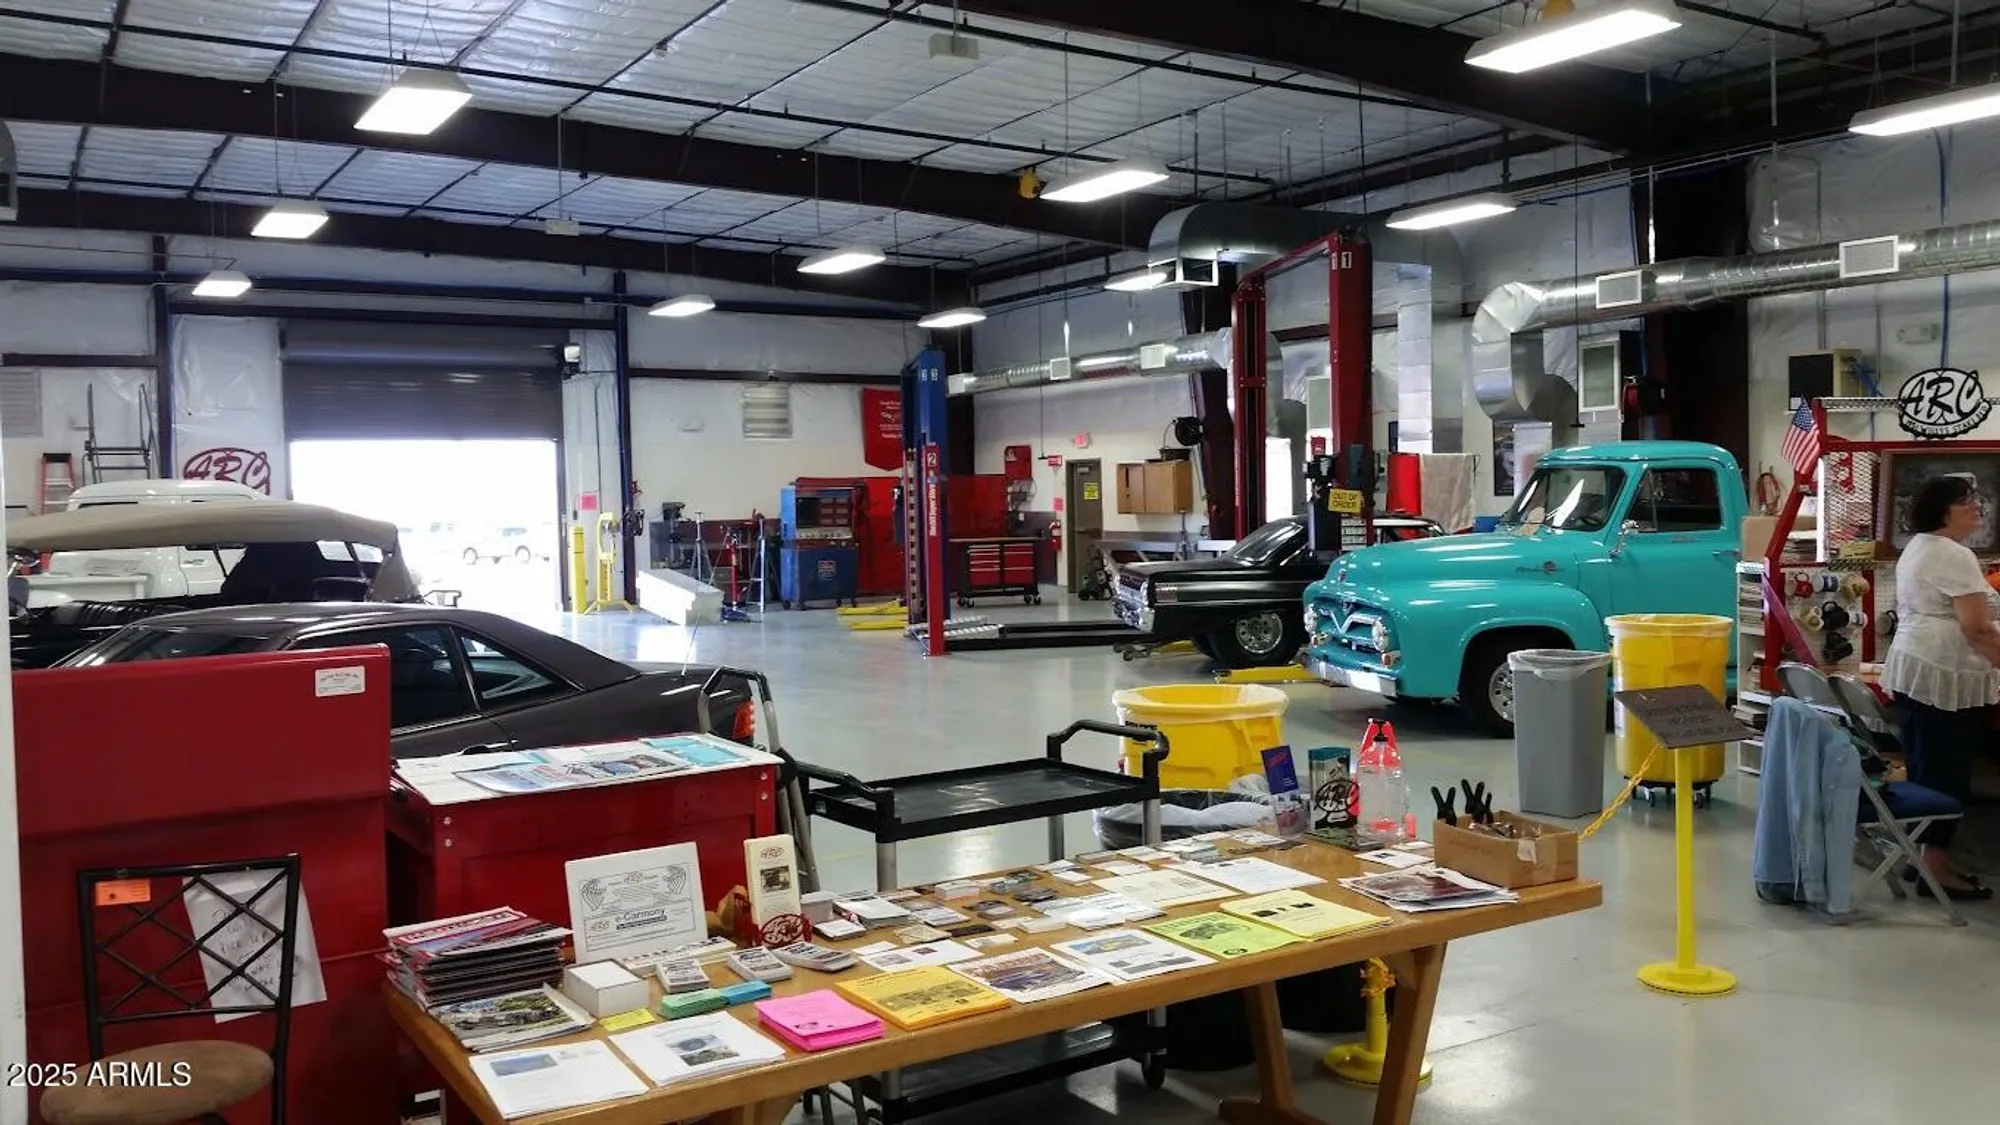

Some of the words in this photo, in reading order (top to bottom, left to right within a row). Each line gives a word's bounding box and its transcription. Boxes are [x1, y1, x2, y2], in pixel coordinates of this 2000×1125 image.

[1902, 370, 1981, 419] ARC
[929, 453, 936, 466] 2
[184, 452, 268, 490] ARC
[1334, 492, 1347, 500] OUT
[1332, 500, 1356, 508] ORDER
